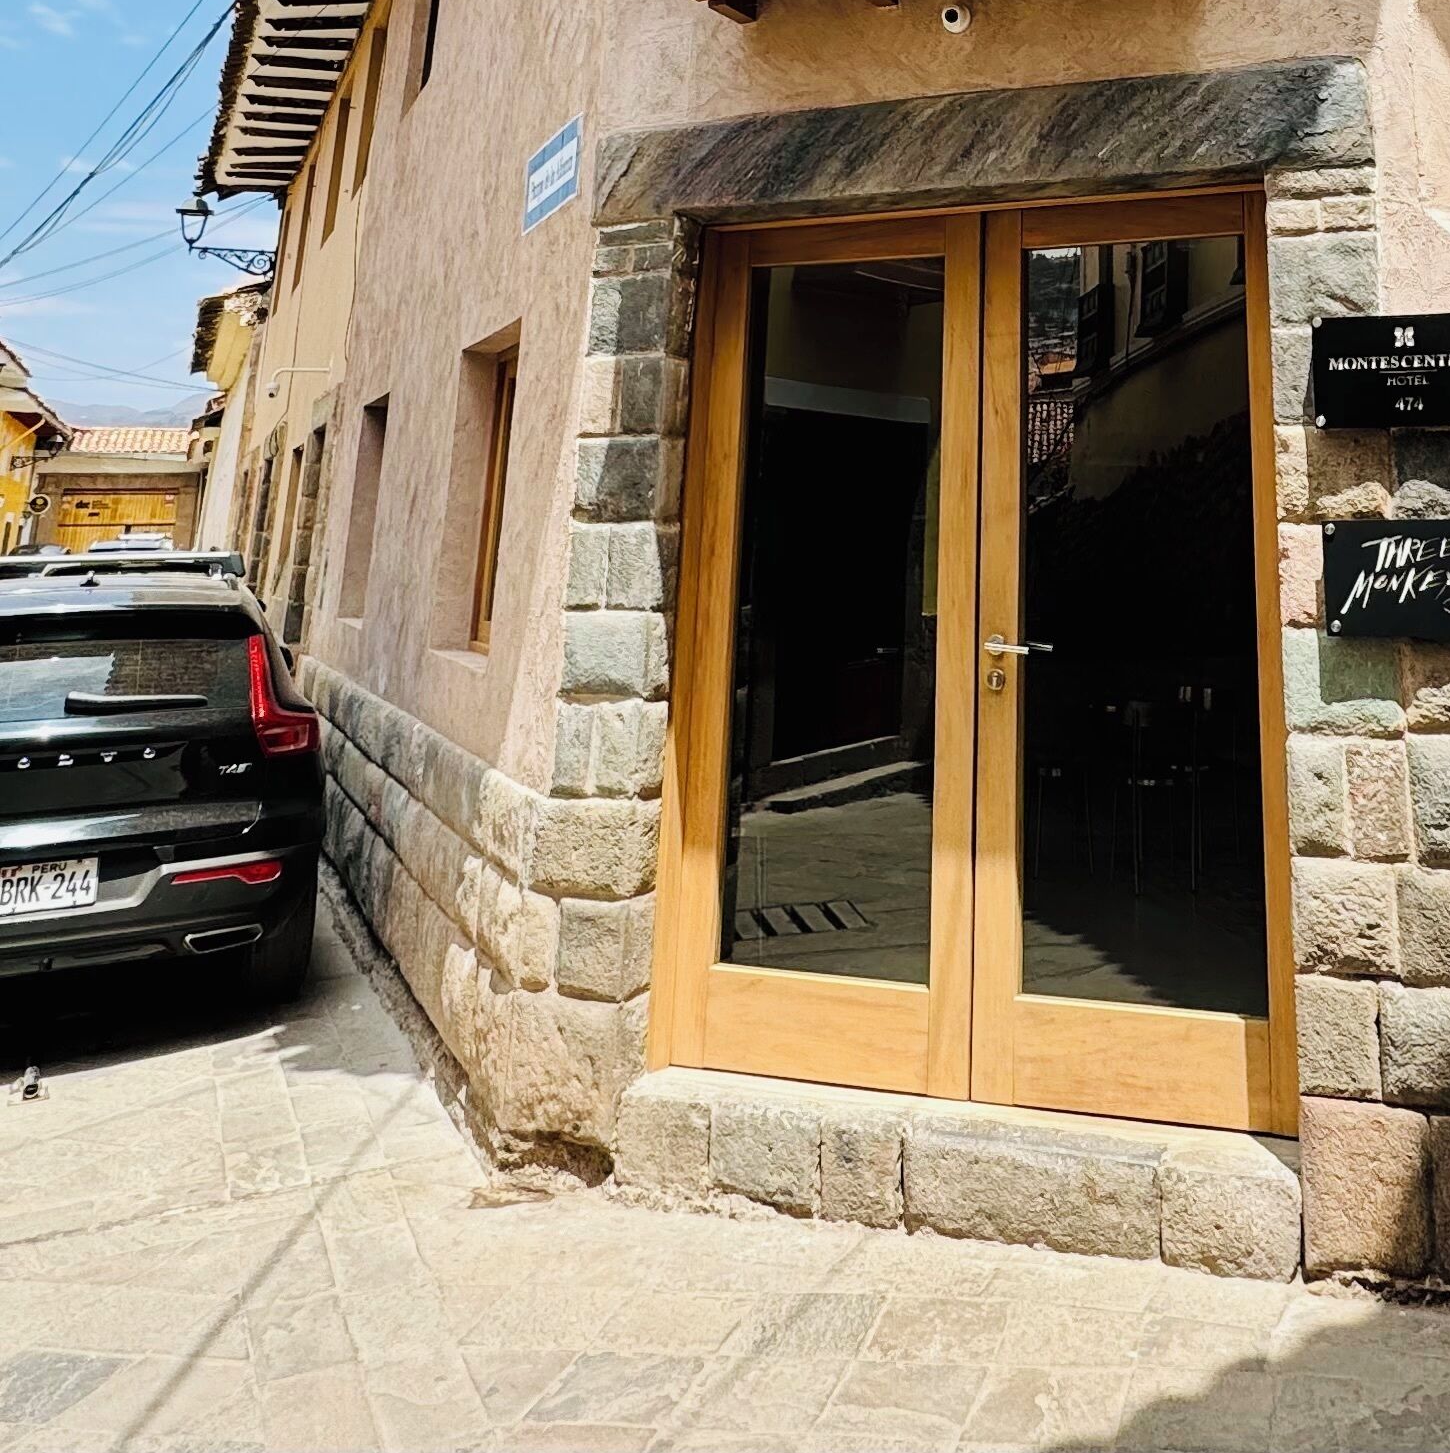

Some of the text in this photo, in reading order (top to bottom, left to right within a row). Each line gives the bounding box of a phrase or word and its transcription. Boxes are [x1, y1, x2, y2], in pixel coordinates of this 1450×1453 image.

[1386, 374, 1429, 386] HOTEL
[1394, 397, 1424, 411] 474
[31, 862, 68, 875] PERU
[0, 869, 92, 906] BRK-244
